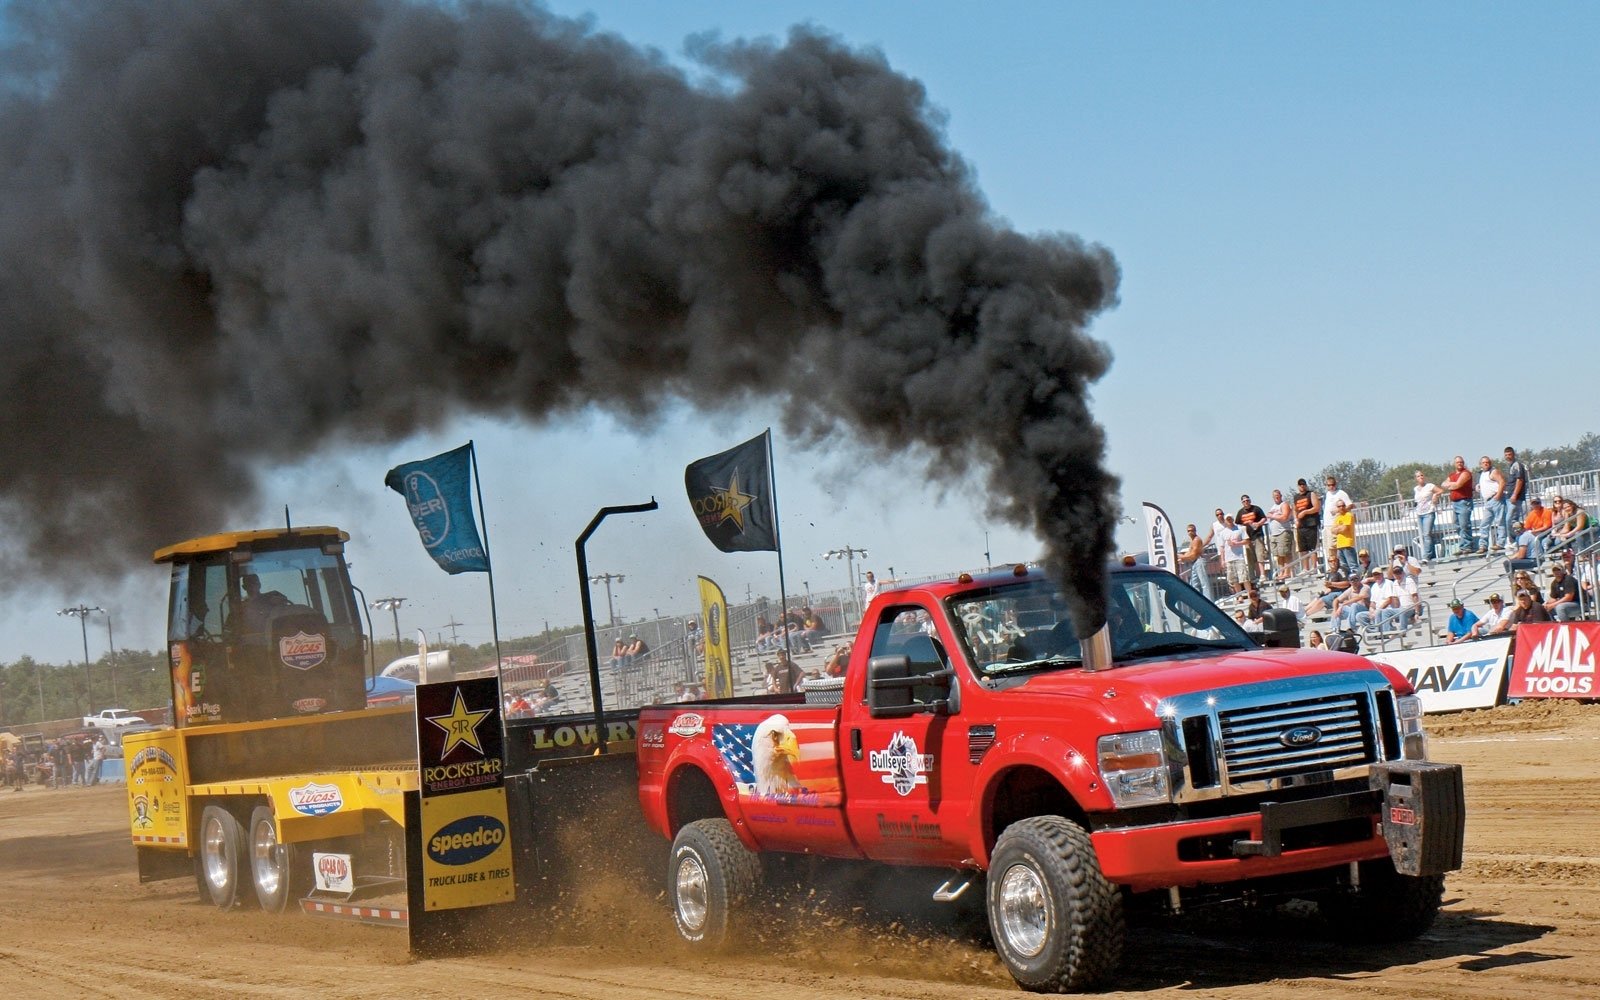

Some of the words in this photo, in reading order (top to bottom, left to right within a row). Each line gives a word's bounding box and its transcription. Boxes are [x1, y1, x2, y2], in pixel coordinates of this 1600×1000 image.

[287, 643, 322, 654] LUCAS
[1526, 624, 1596, 674] MAC
[1525, 676, 1593, 694] TOOLS
[186, 704, 202, 716] Spark
[202, 702, 220, 715] Plugs
[1292, 730, 1314, 743] Ford
[431, 778, 466, 790] ENERGY
[469, 774, 498, 784] DRINK
[299, 792, 337, 804] LUCAS
[308, 801, 341, 809] PRODUCTS
[431, 826, 503, 856] speedco
[320, 858, 337, 875] LUCAS
[429, 875, 456, 887] TRUCK
[457, 872, 478, 884] LUBE
[479, 871, 486, 880] &
[488, 868, 511, 880] TIRES
